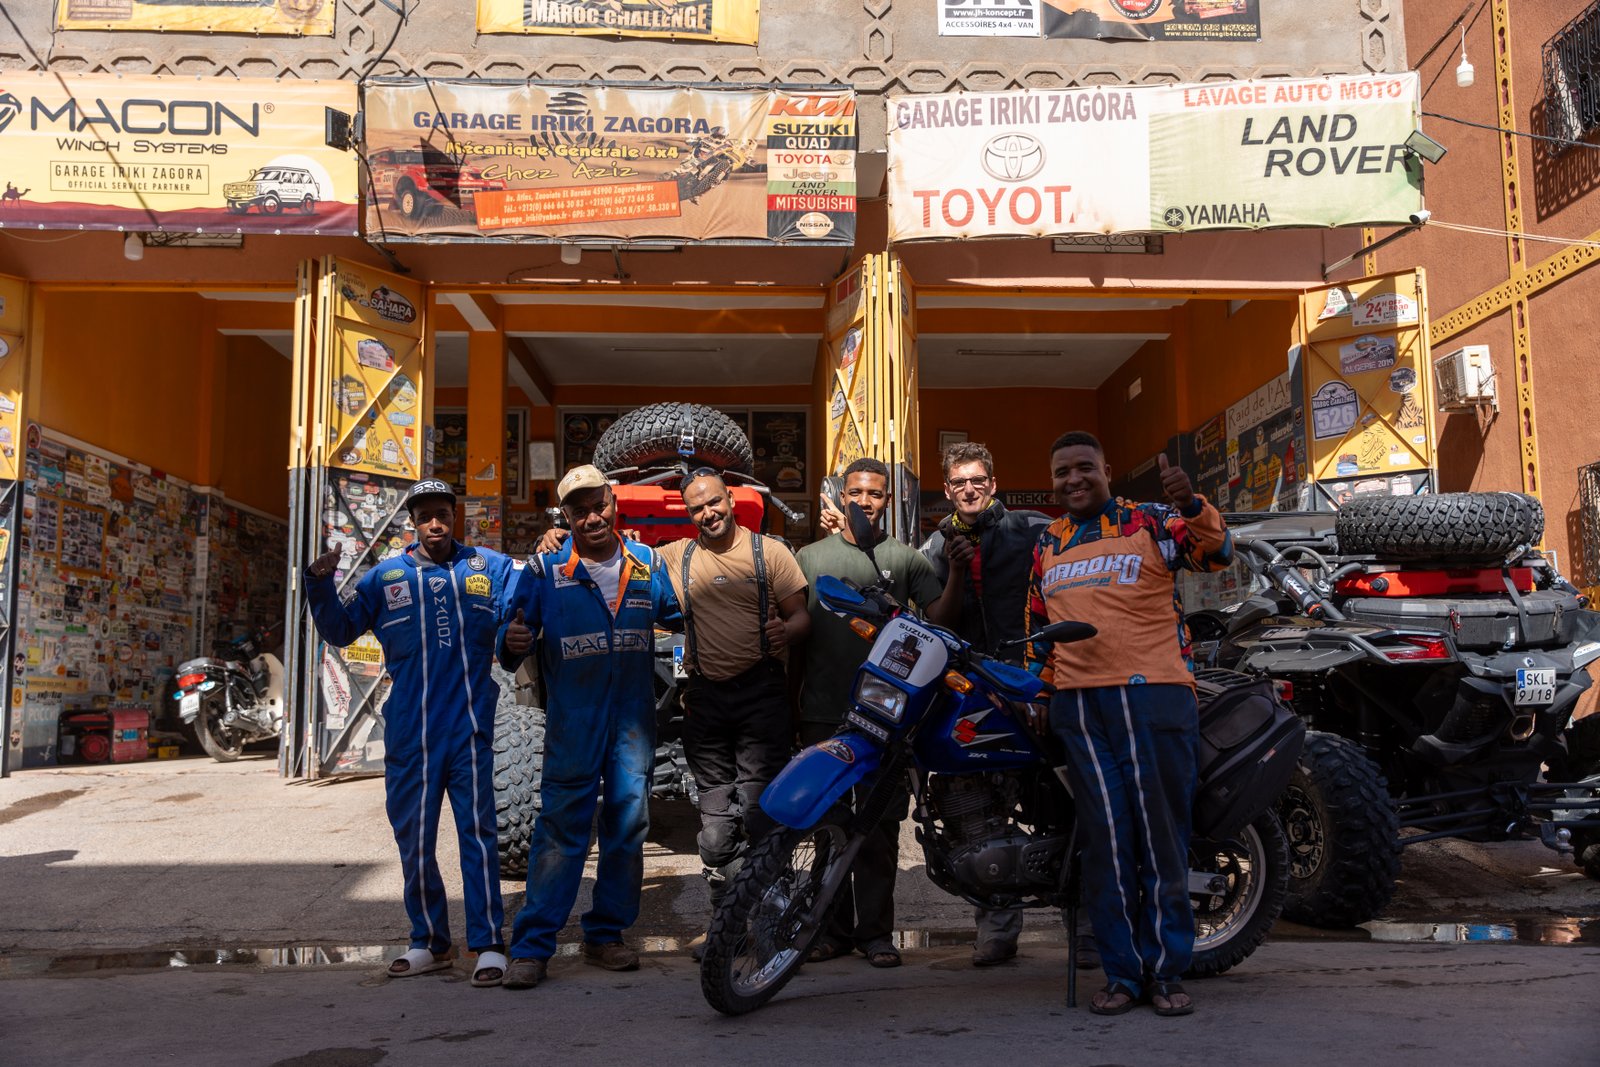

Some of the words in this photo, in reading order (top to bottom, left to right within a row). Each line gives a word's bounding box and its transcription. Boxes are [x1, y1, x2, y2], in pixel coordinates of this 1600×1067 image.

[531, 0, 599, 24] MAROC
[603, 3, 707, 30] CHALLENGE
[953, 9, 1026, 18] www.jh-koncept.fr
[1184, 85, 1267, 107] LAVAGE
[1274, 83, 1332, 103] AUTO
[1340, 79, 1402, 100] MOTO
[768, 95, 856, 116] KTM
[897, 98, 983, 130] GARAGE
[990, 95, 1040, 126] IRIKI
[1047, 92, 1137, 123] ZAGORA
[30, 96, 259, 138] MACON
[413, 111, 522, 131] GARAGE
[532, 114, 595, 133] IRIKI
[604, 116, 711, 134] ZAGORA
[773, 123, 849, 136] SUZUKI
[1241, 113, 1358, 146] LAND
[56, 137, 120, 153] WINCH
[133, 139, 228, 155] SYSTEMS
[445, 141, 550, 159] Mécanique
[555, 143, 641, 159] Générale
[644, 146, 679, 159] 4x4
[785, 136, 830, 149] QUAD
[775, 154, 832, 164] TOYOTA
[1264, 144, 1413, 178] ROVER
[55, 164, 105, 178] GARAGE
[112, 165, 146, 179] IRIKI
[152, 167, 203, 180] ZAGORA
[480, 164, 559, 181] Chez
[572, 161, 639, 179] Aziz
[783, 169, 838, 182] Jeep
[68, 181, 108, 191] OFFICIAL
[115, 182, 149, 191] SERVICE
[152, 183, 191, 192] PARTNER
[775, 196, 854, 211] MITSUBISHI
[913, 185, 1076, 228] TOYOT
[1185, 202, 1270, 225] YAMAHA
[371, 298, 412, 318] SAHARA
[1228, 397, 1251, 431] Raid
[1253, 391, 1265, 412] de
[1316, 405, 1356, 431] 526
[434, 595, 452, 649] MACON
[898, 621, 934, 643] SUZUKI
[346, 652, 381, 663] CHALLENGE
[1526, 673, 1548, 685] SKL
[1518, 688, 1552, 701] 9J18
